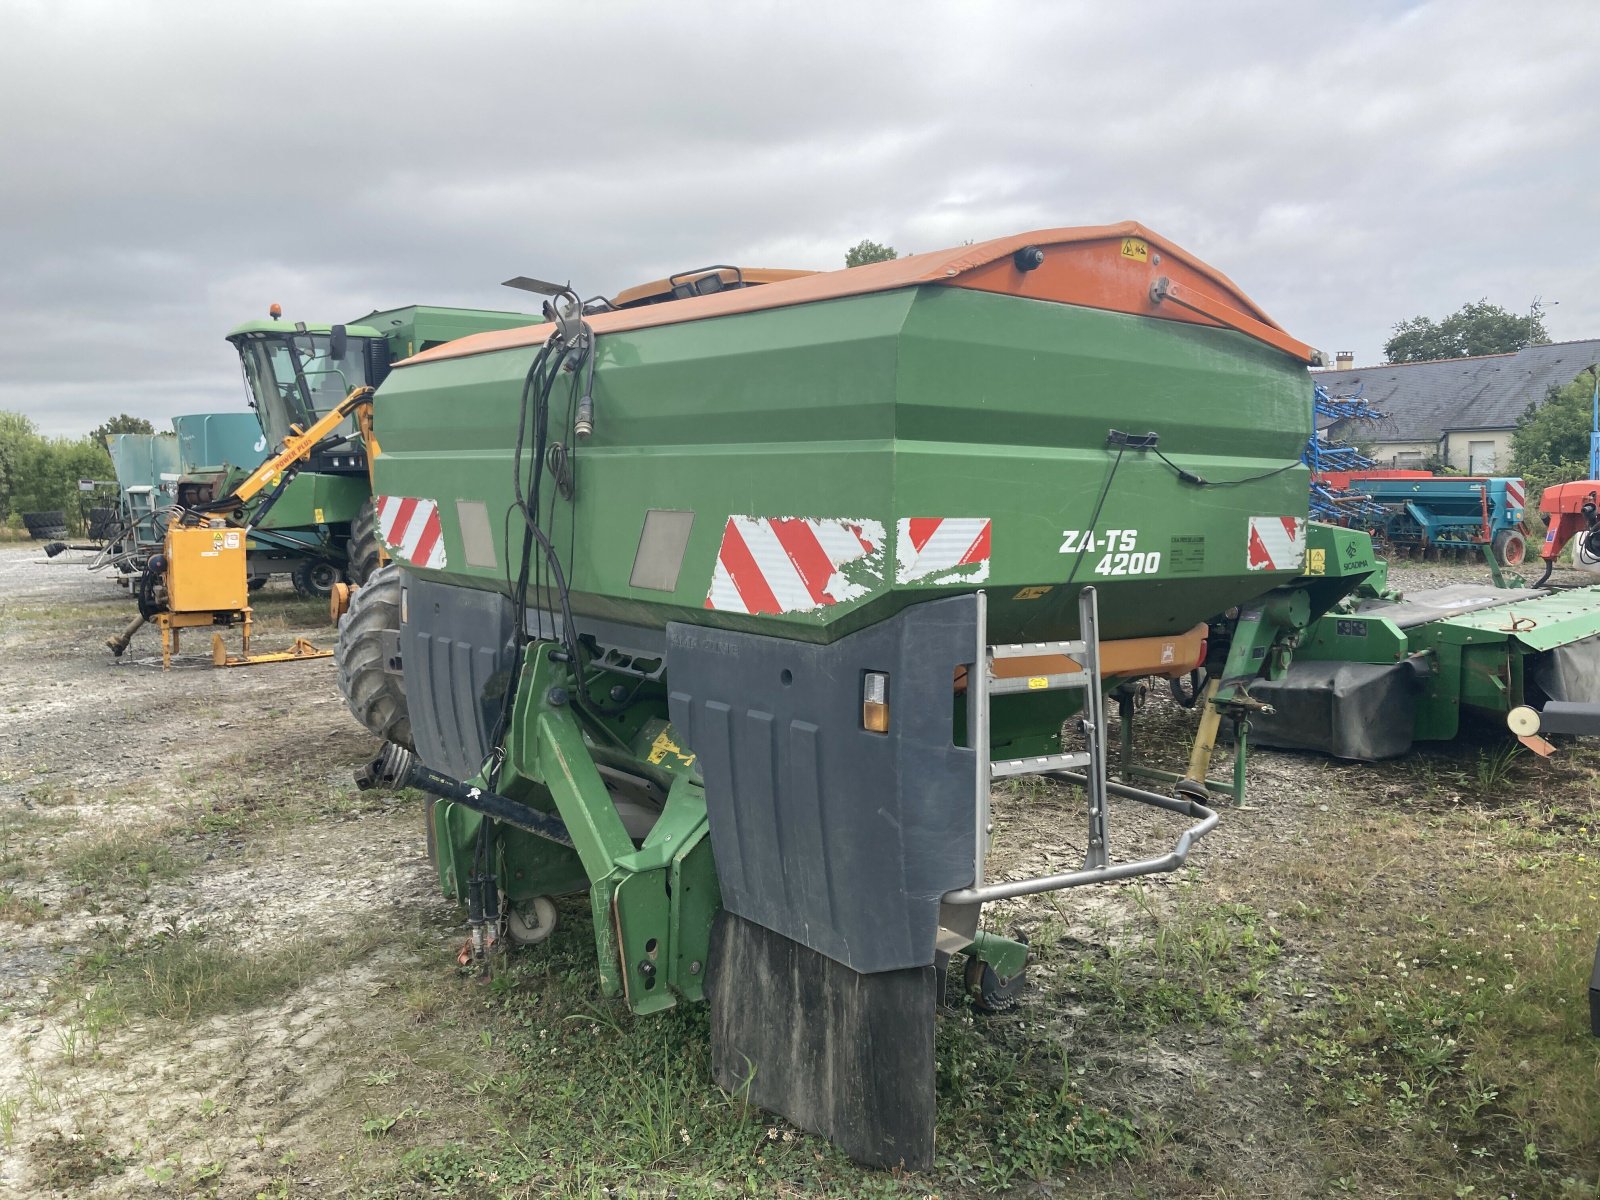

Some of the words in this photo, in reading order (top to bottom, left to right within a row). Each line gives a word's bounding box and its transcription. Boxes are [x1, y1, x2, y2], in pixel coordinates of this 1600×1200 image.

[275, 451, 297, 470] POWER
[1059, 529, 1138, 553] ZA-TS
[1094, 551, 1161, 576] 4200
